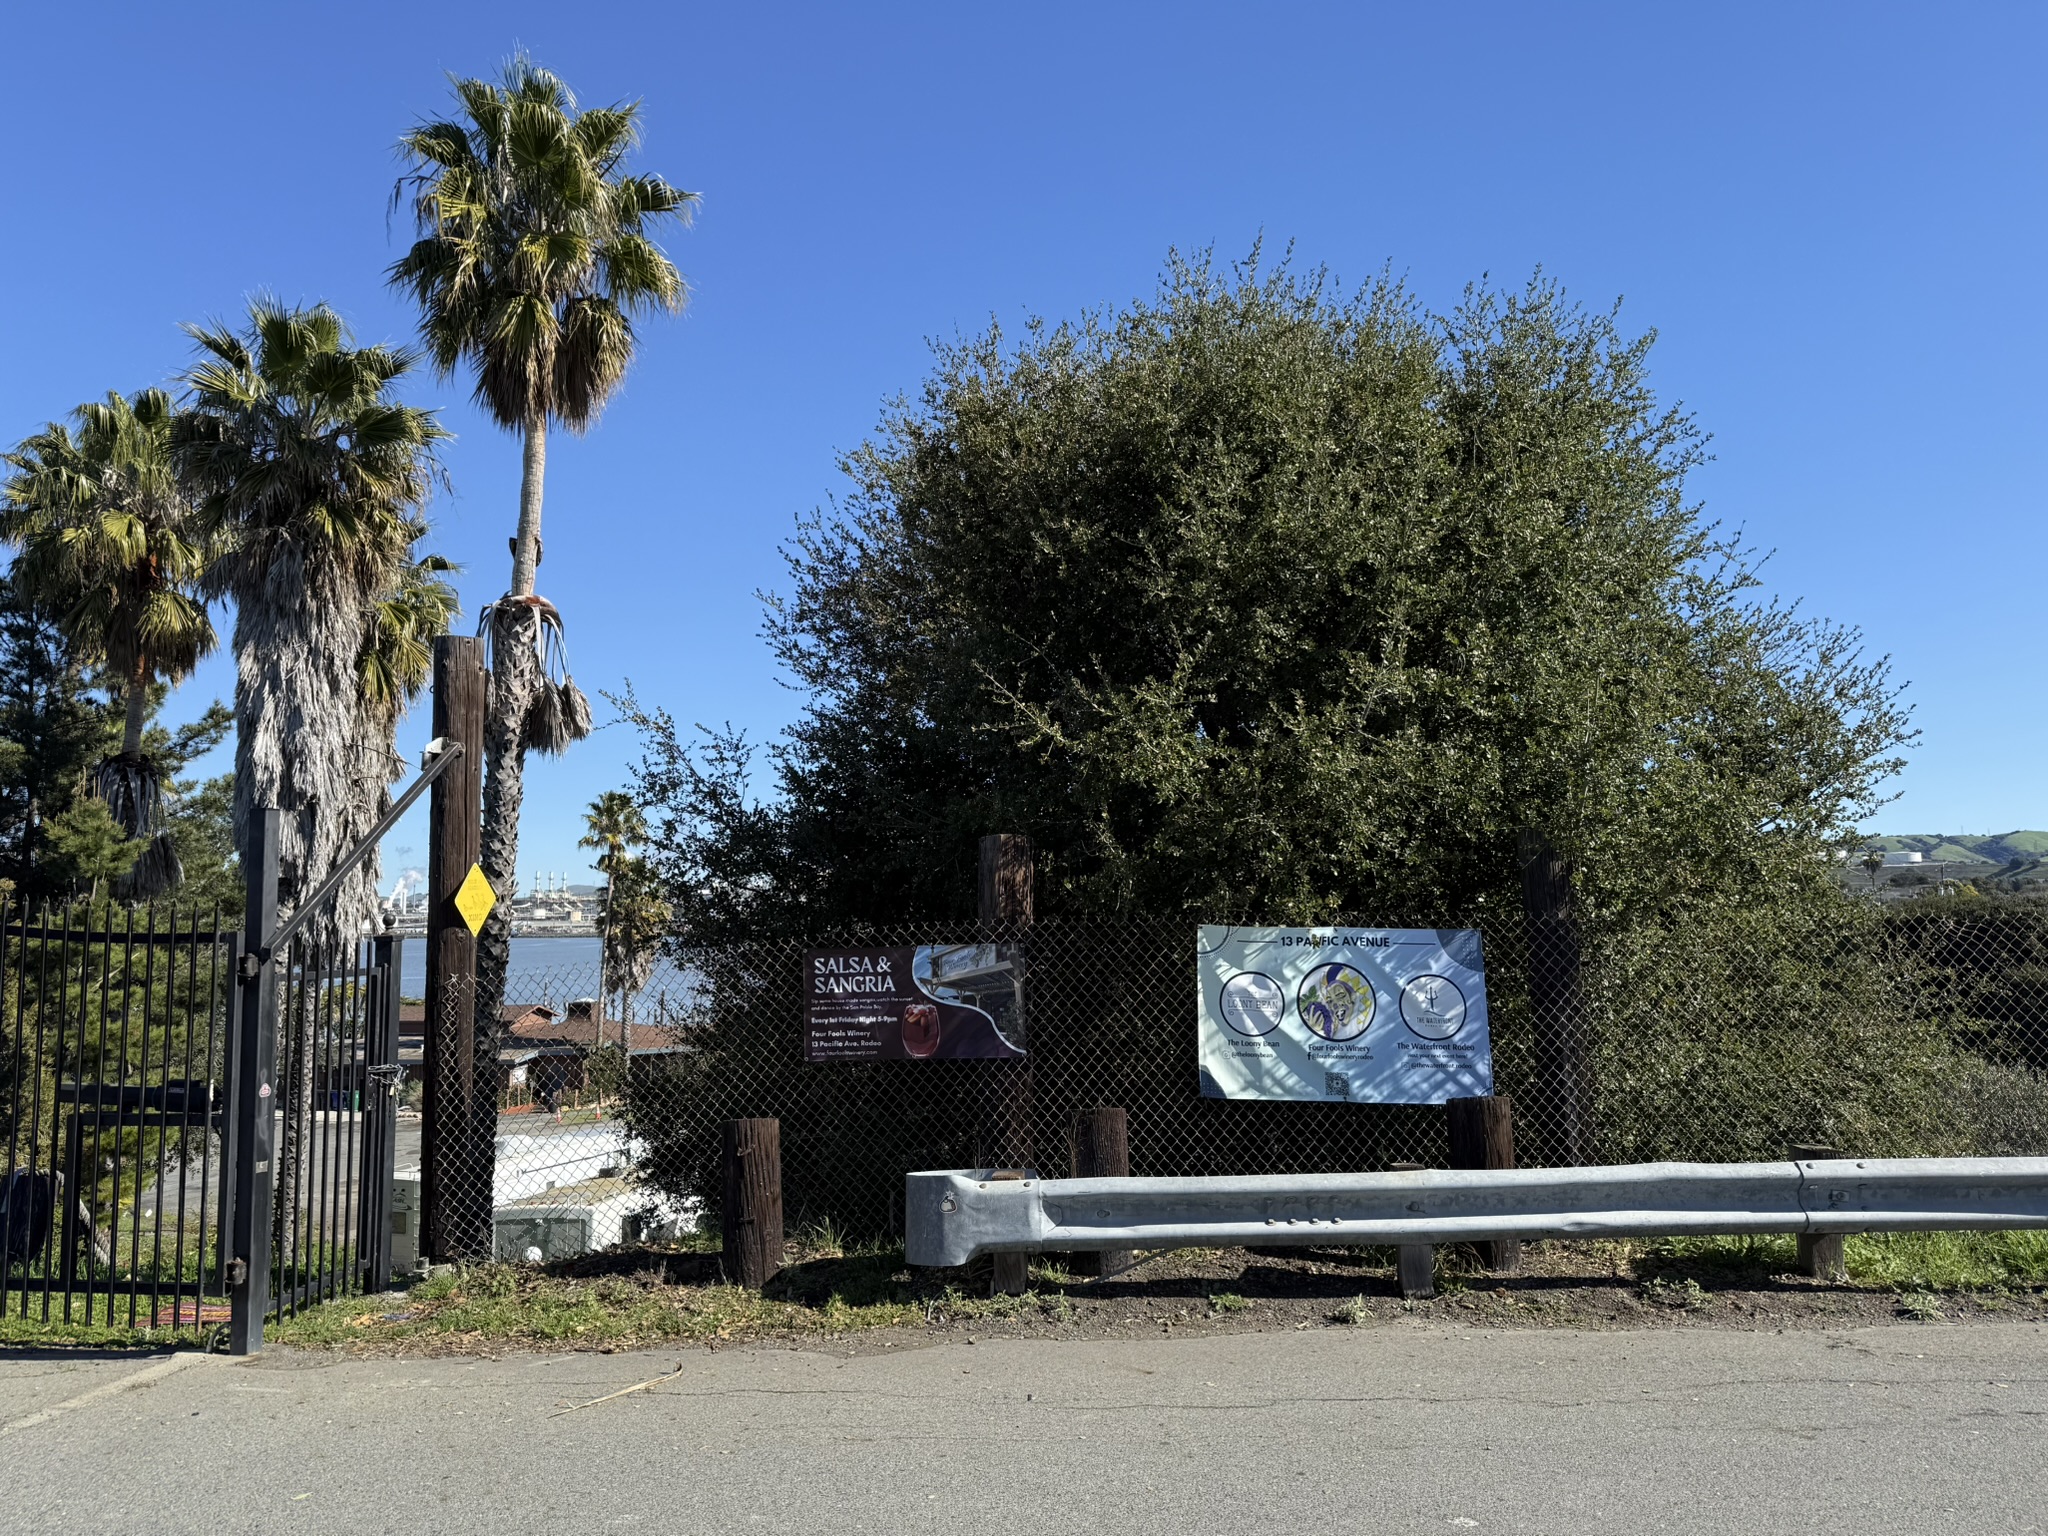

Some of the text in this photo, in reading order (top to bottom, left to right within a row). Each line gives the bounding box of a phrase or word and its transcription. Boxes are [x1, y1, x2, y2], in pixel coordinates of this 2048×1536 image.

[1281, 936, 1293, 947] 13
[1342, 936, 1390, 947] AVENUE
[814, 956, 892, 974] SALSA &
[815, 975, 896, 993] SANGRIA
[1255, 1001, 1278, 1010] BEAN
[811, 1017, 828, 1025] Every
[838, 1016, 858, 1024] Friday
[859, 1016, 876, 1024] Night
[877, 1015, 898, 1023] 5-9pm
[847, 1029, 871, 1038] Winery
[1241, 1040, 1261, 1048] Loony
[1345, 1044, 1371, 1053] Winery
[1397, 1042, 1475, 1051] The Waterfront Rodeo
